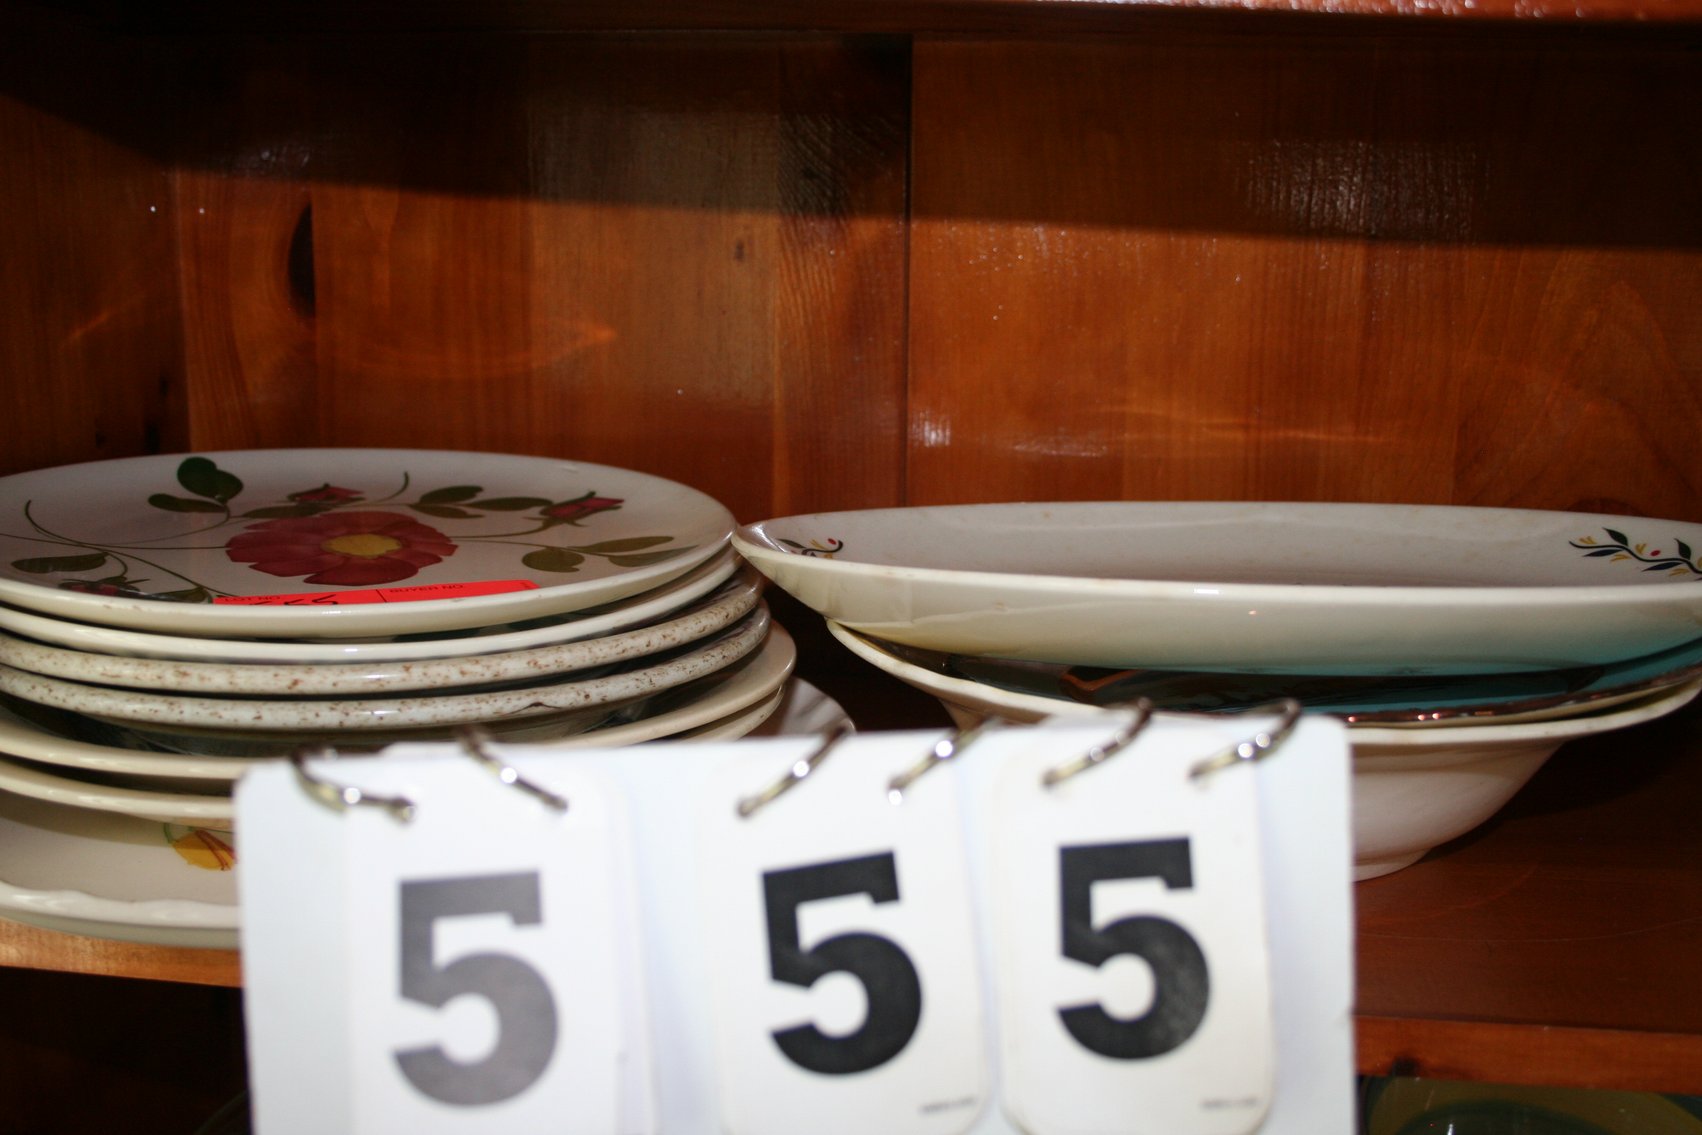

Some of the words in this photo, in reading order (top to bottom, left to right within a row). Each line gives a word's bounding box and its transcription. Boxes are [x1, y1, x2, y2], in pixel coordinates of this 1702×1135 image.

[389, 585, 439, 593] BUYER
[391, 871, 560, 1110] 5
[762, 851, 922, 1076] 5
[1058, 837, 1210, 1062] 5
